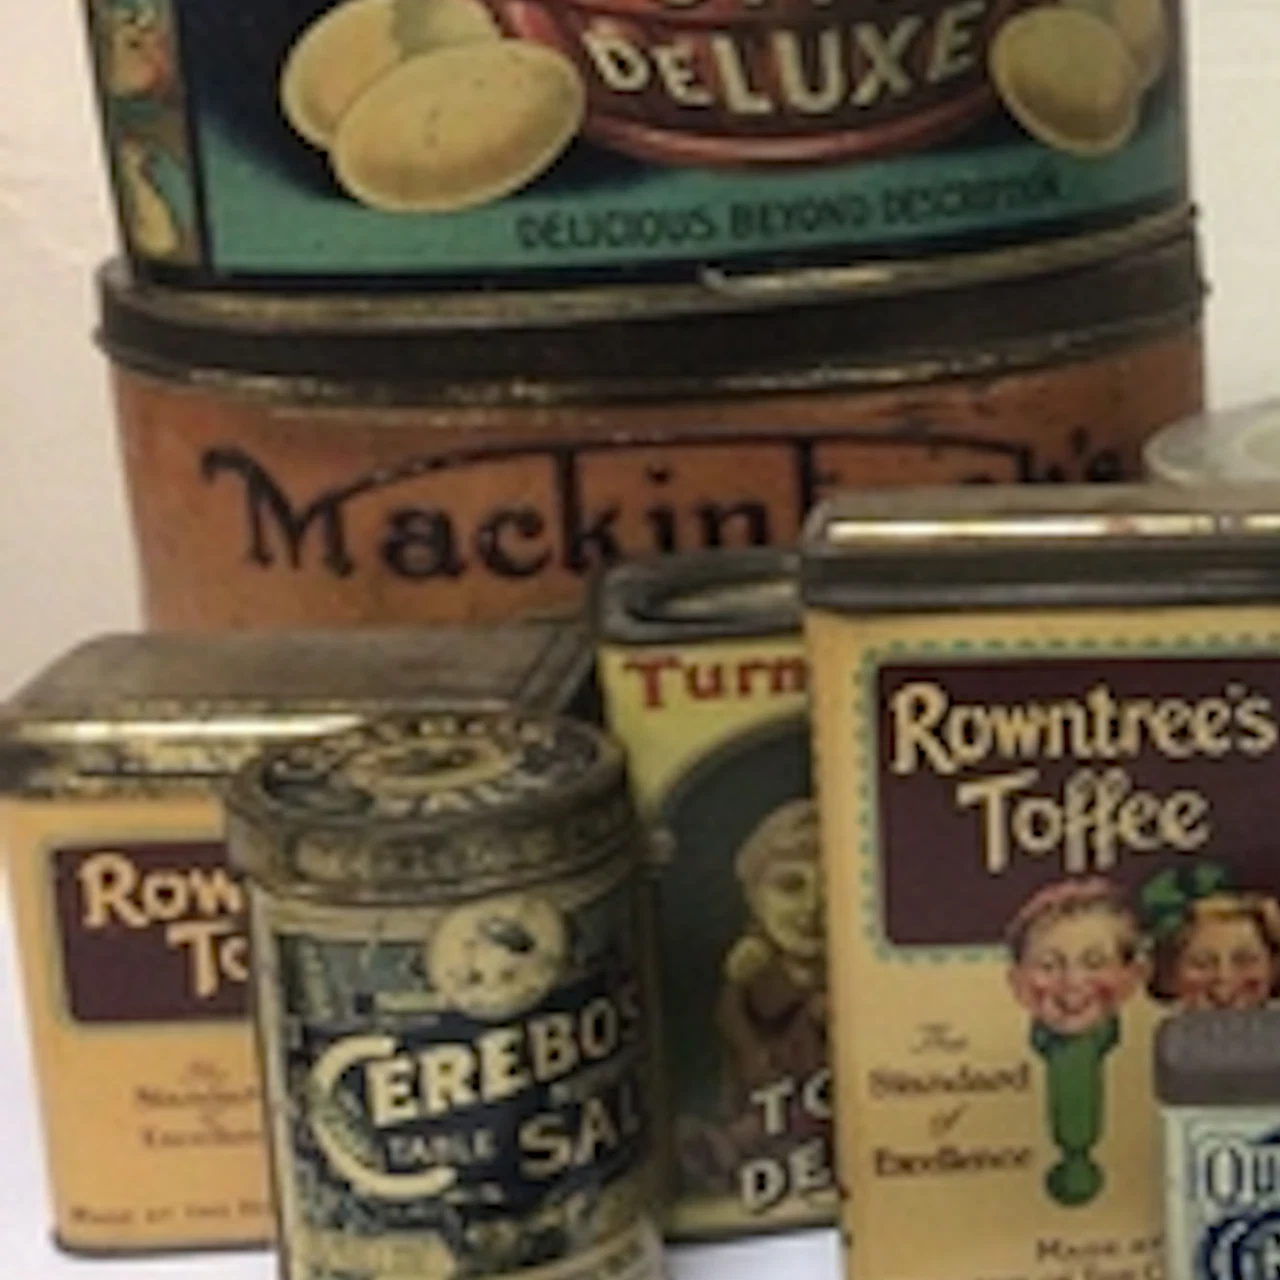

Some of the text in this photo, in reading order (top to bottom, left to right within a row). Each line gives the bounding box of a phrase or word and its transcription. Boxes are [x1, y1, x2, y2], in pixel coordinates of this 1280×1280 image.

[622, 652, 808, 710] Turn
[955, 770, 1212, 876] Toffee
[868, 1060, 1034, 1100] Standard
[872, 1146, 1037, 1178] Excellence
